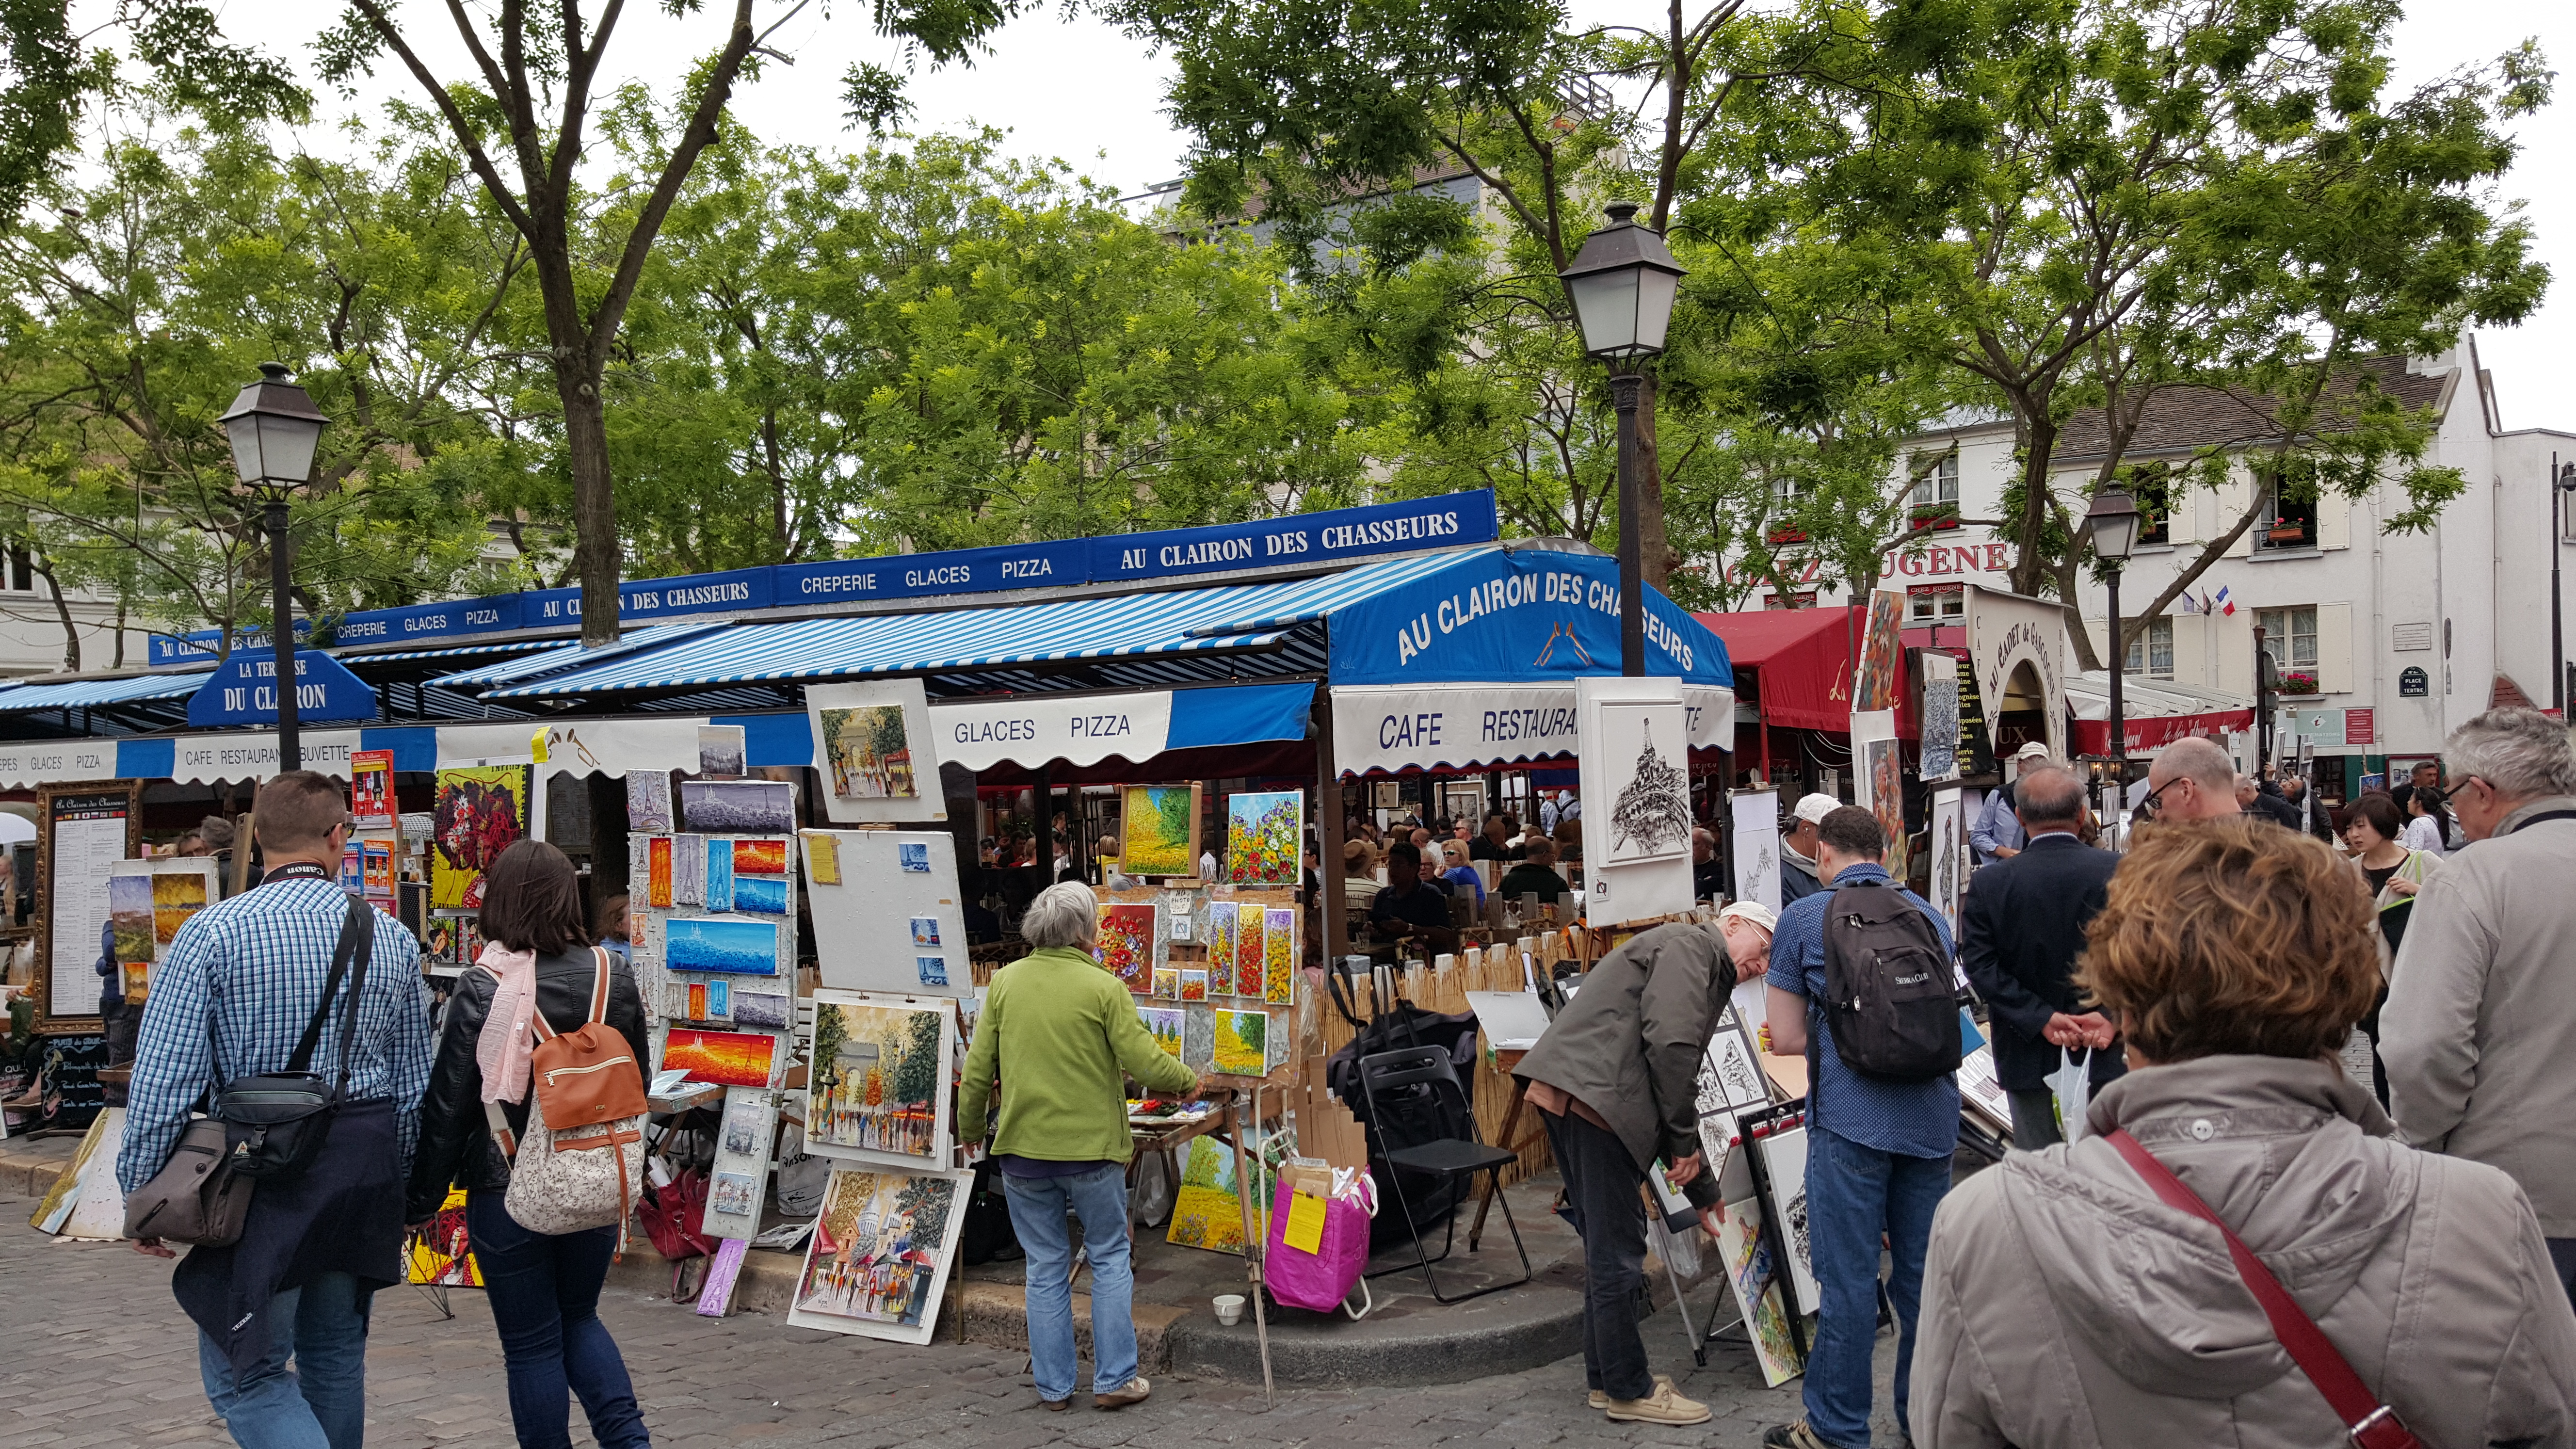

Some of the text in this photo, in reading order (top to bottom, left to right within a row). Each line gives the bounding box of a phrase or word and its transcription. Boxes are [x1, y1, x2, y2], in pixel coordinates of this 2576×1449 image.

[1121, 512, 1458, 570] AU CLAIRON DES CHASSEURS
[1879, 543, 2008, 579] UGÈNE
[801, 558, 1052, 594] CREPERIE GLACES PIZZA
[543, 601, 560, 619] AU
[633, 591, 660, 611] DES
[667, 582, 749, 607] CHASSEURS
[338, 609, 499, 639] CREPERIE GLACES PIZZA
[1398, 571, 1693, 672] AU CLAIRON DES CHASEURS
[162, 643, 174, 657] AU
[178, 638, 219, 656] CLAIRON
[231, 636, 242, 651] ES
[239, 660, 306, 678] LA TERSE
[1989, 663, 1999, 700] AU
[2030, 622, 2055, 701] GASCOGNE
[224, 684, 326, 711] DU CLRON
[954, 714, 1131, 744] GLACES PIZZA
[1379, 712, 1443, 749] CAFE
[1483, 708, 1578, 742] RESTAURA
[31, 756, 62, 770] GLACES
[77, 755, 100, 769] PIZZA
[186, 745, 350, 765] CAFE RESTAURAN BUVETTE
[98, 797, 126, 806] Chasseurs
[287, 866, 324, 876] Canon
[1895, 976, 1916, 985] SIERRA
[231, 1312, 253, 1331] TEZENIS
